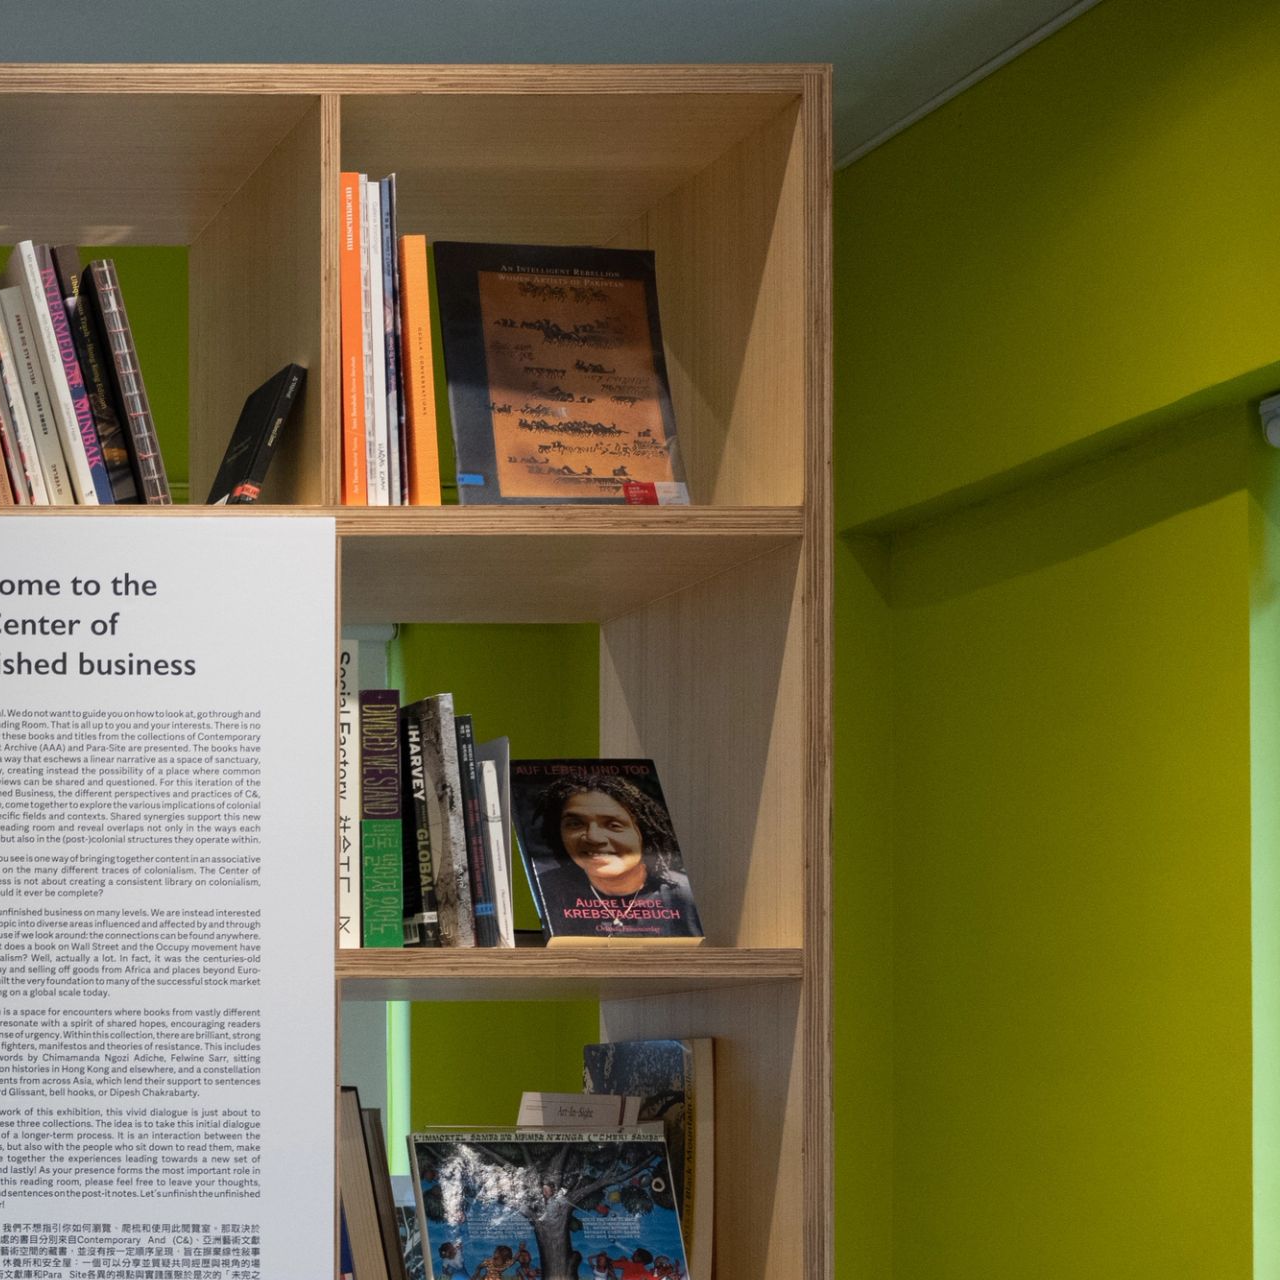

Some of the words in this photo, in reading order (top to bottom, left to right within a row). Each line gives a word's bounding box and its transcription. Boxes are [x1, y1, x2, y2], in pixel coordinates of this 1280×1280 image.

[501, 265, 514, 274] AN
[73, 398, 103, 469] MINBAK
[71, 576, 101, 597] to
[110, 572, 158, 597] the
[90, 611, 121, 636] of
[78, 651, 196, 676] business
[417, 829, 433, 893] GLOBAL
[563, 908, 680, 920] KREBSTAGEBUCH
[575, 898, 619, 909] AUDRE
[621, 898, 663, 909] LORDE
